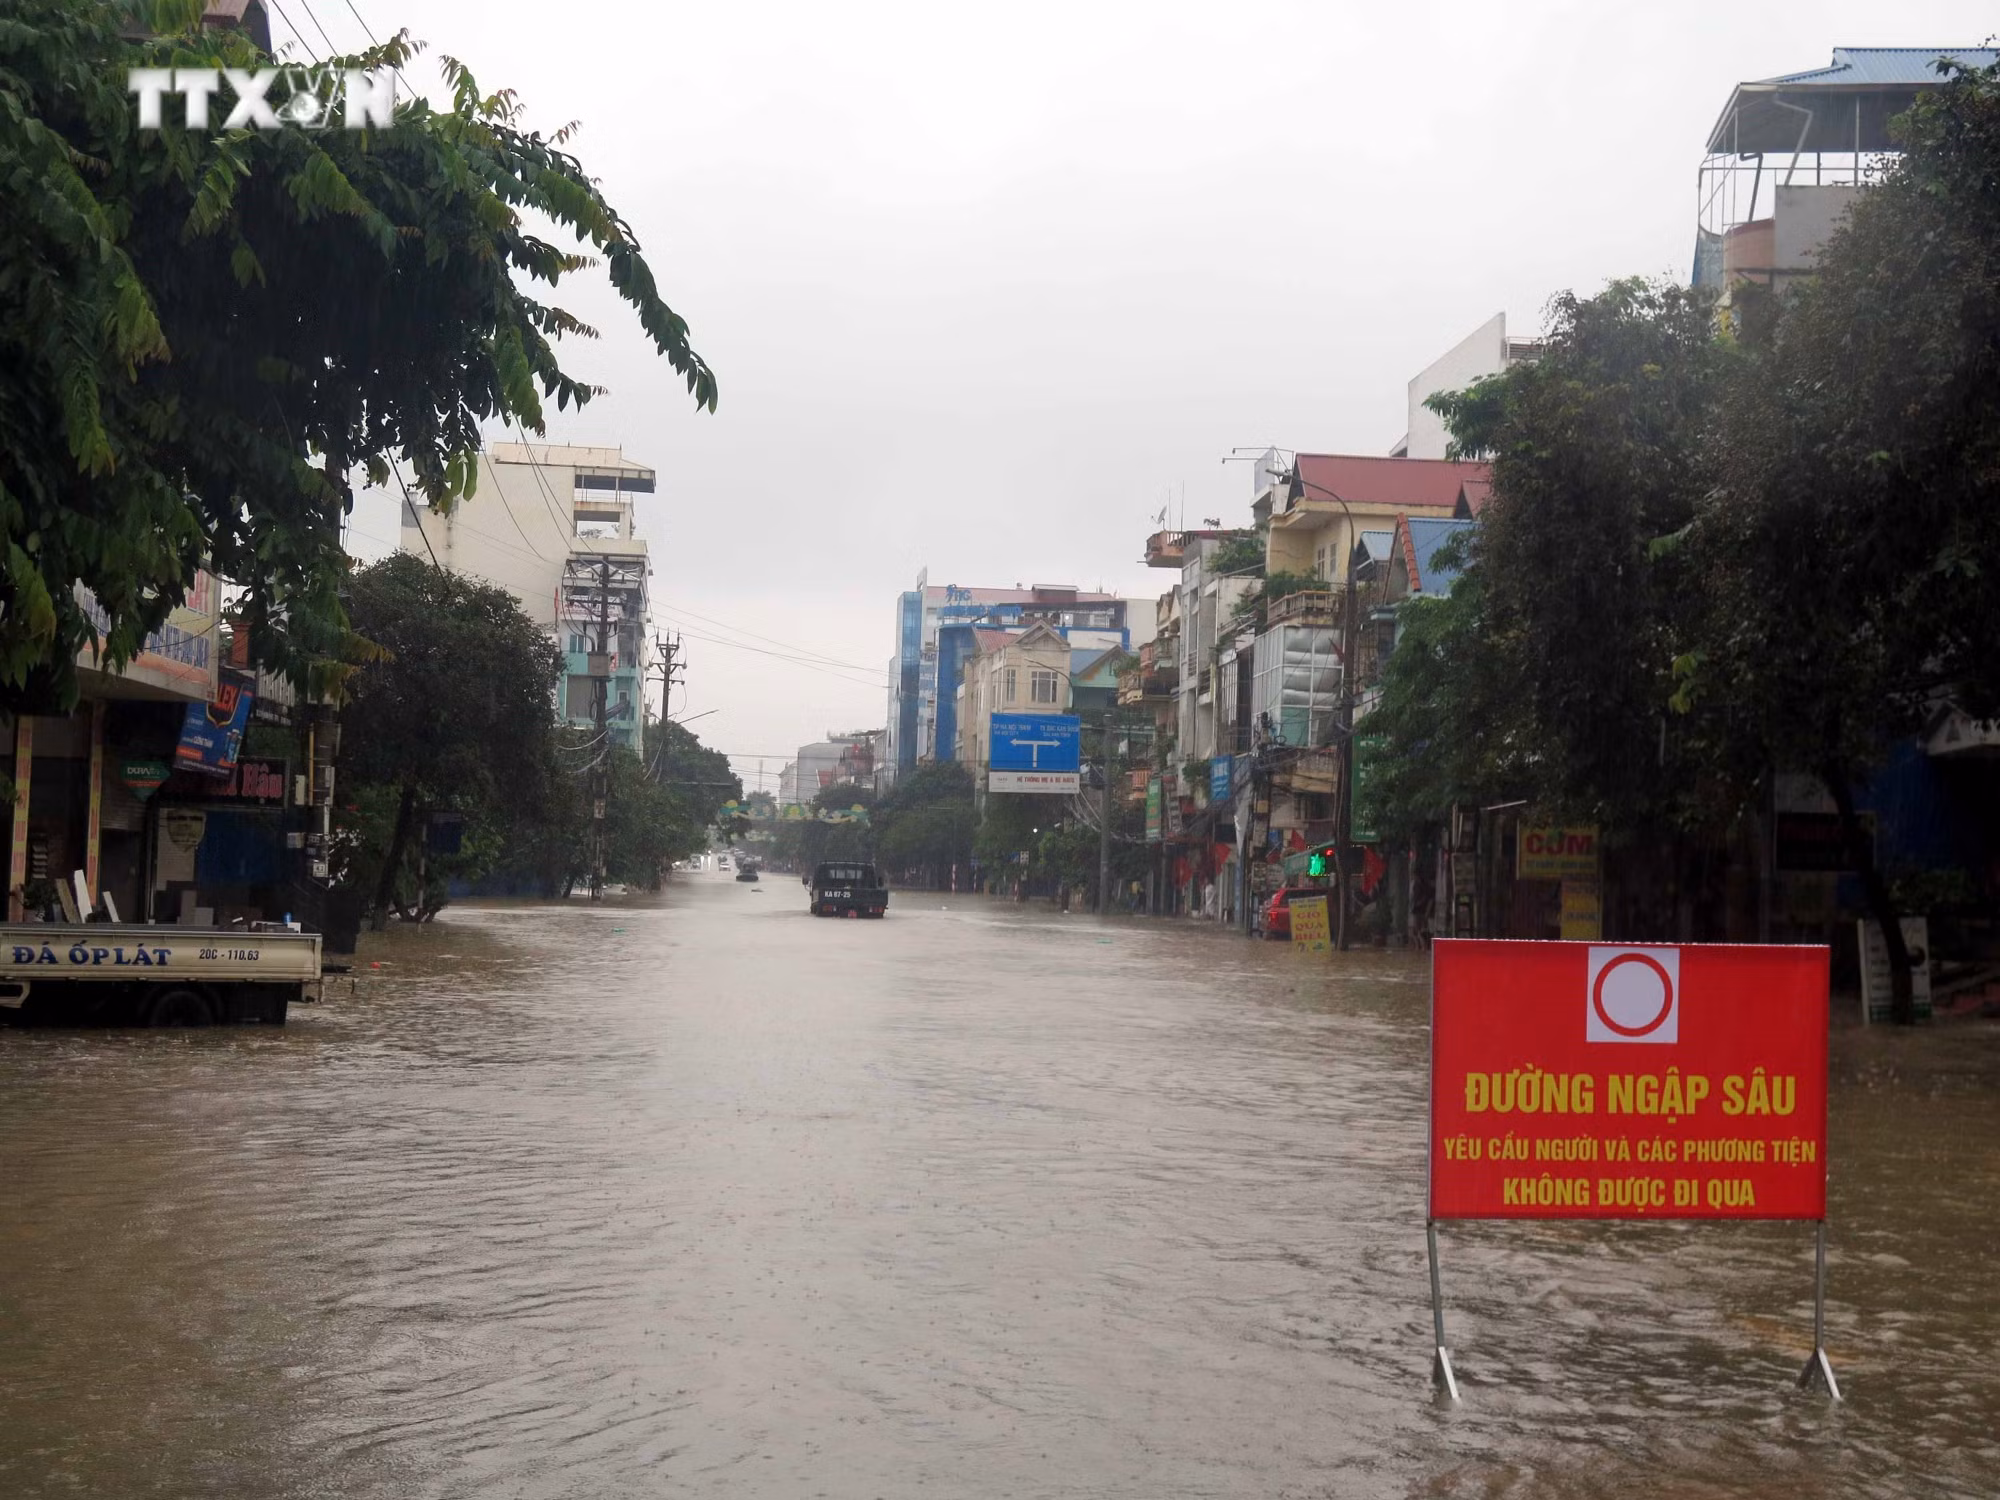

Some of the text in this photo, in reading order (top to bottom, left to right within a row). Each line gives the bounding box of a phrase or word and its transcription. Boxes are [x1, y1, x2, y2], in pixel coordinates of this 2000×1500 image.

[12, 941, 59, 965] ĐÁ
[1465, 1063, 1796, 1124] ĐƯỜNG NGẬP SÂU
[1444, 1133, 1482, 1161] YÊU
[1535, 1134, 1599, 1161] NGƯỜI
[1604, 1135, 1631, 1162] VÀ
[1637, 1136, 1677, 1162] CÁC
[1683, 1137, 1766, 1163] PHƯƠNG
[1771, 1136, 1816, 1167] TIỆN
[1503, 1172, 1756, 1213] KHÔNG ĐƯỢC ĐI QUA
